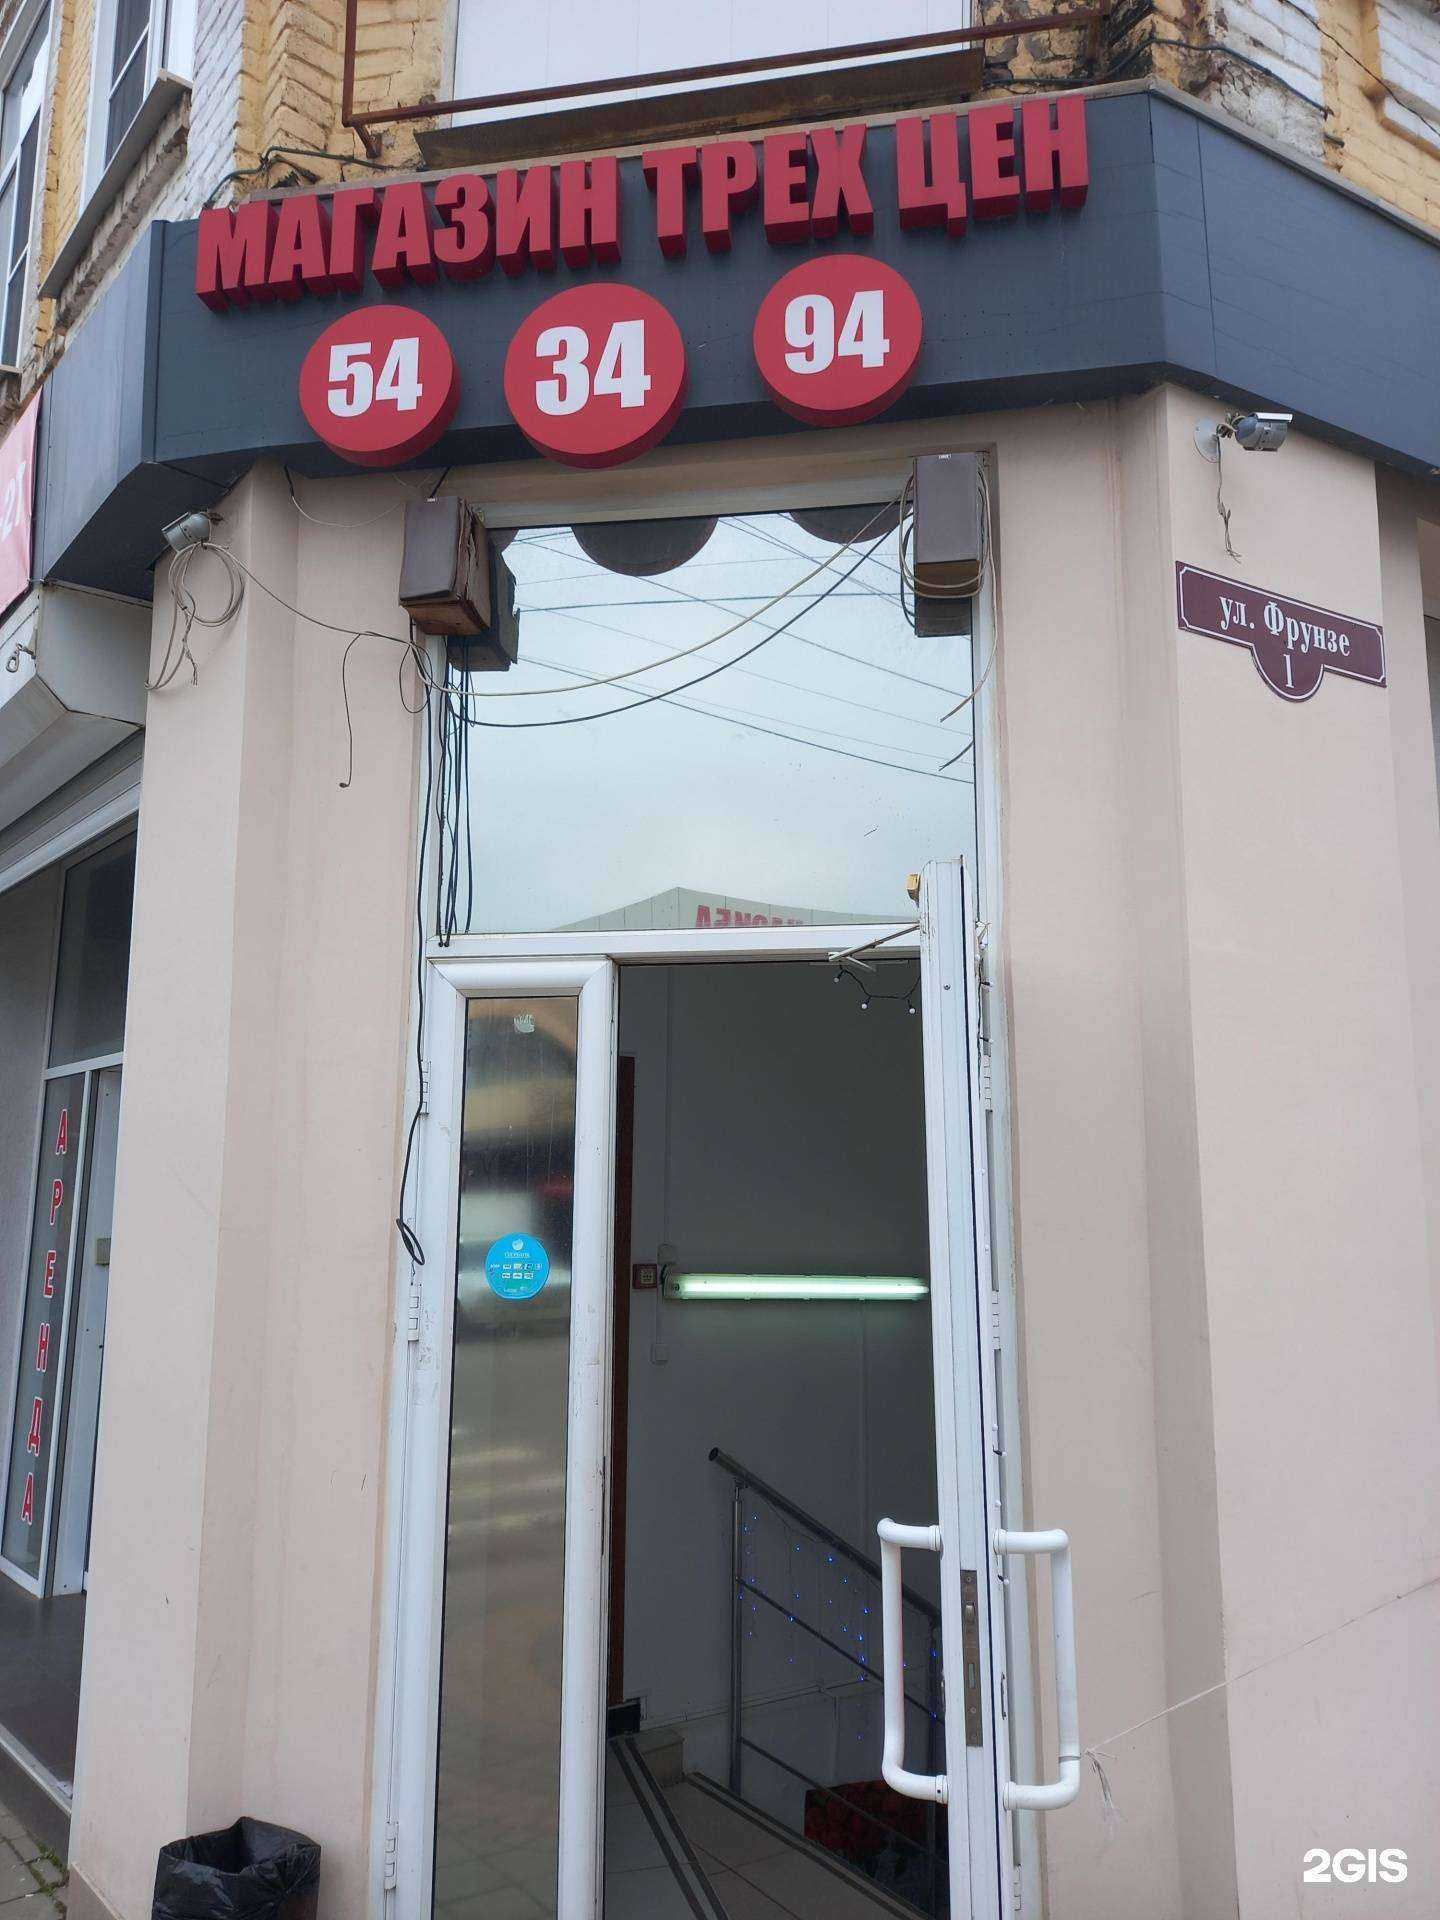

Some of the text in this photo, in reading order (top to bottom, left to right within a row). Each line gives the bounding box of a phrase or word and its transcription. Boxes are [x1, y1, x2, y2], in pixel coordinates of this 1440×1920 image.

[196, 94, 1089, 304] МАГАЗИН ТРЕХ ЦЕН
[535, 319, 652, 417] 34
[784, 289, 890, 375] 94
[327, 337, 423, 418] 54
[1219, 596, 1351, 657] ул. Фрунзе
[1283, 653, 1295, 689] 1
[21, 1109, 68, 1526] АРЕНДА
